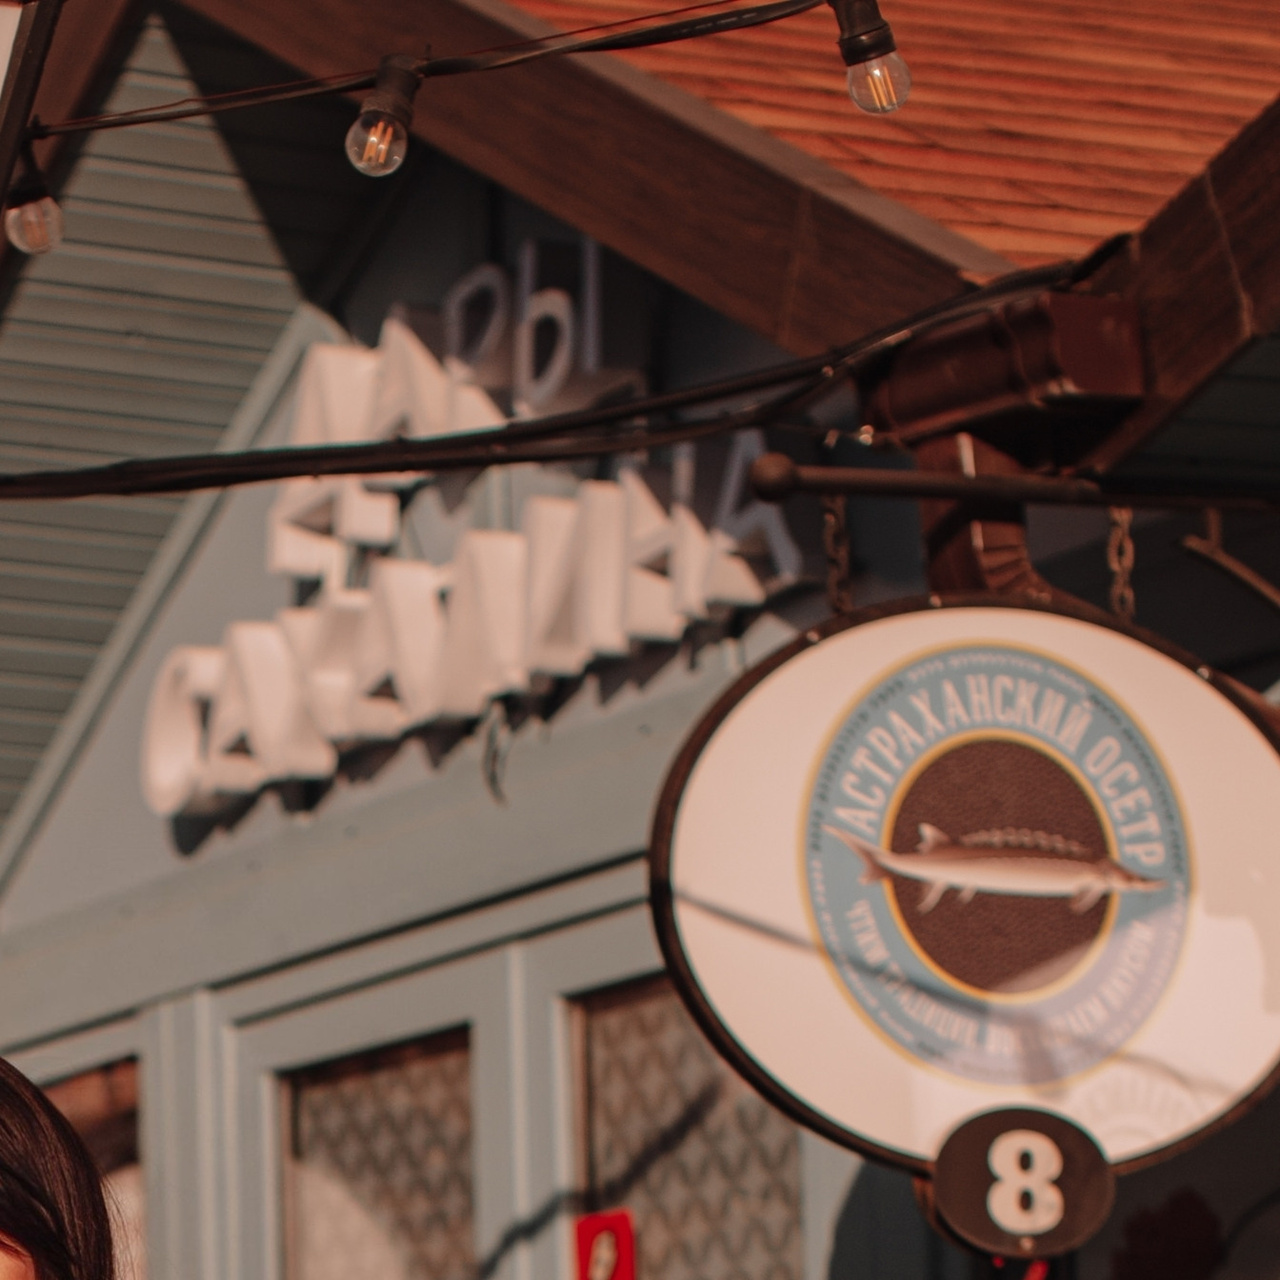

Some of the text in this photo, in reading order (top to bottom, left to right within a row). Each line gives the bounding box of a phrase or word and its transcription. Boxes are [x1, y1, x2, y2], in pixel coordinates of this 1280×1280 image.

[834, 674, 1093, 843] АСТРАХАНСКИЙ
[1086, 737, 1167, 868] ОСЕТР
[985, 1129, 1065, 1235] 8
